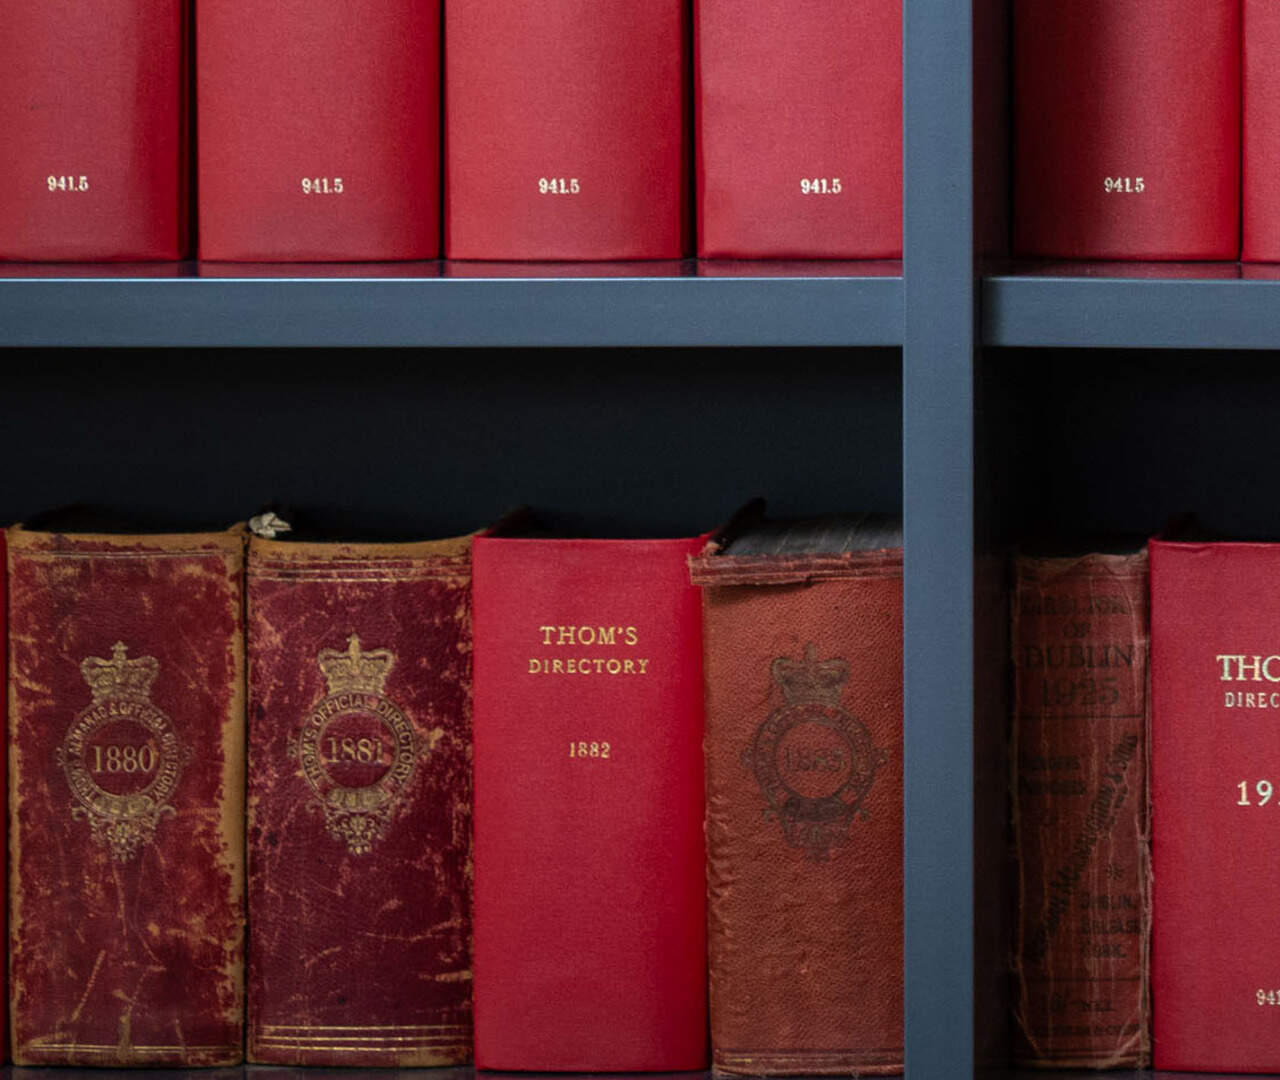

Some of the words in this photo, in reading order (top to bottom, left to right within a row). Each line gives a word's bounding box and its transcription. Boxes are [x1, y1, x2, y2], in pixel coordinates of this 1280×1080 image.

[48, 176, 88, 191] 941.5
[302, 178, 343, 194] 941.5
[539, 178, 579, 194] 941.5
[801, 179, 841, 194] 941.5
[1104, 177, 1144, 192] 941.5
[540, 626, 637, 645] THOM'S
[528, 659, 648, 674] DIRECTORY
[328, 737, 387, 765] 1881
[570, 742, 610, 758] 1882
[91, 745, 156, 773] 1880
